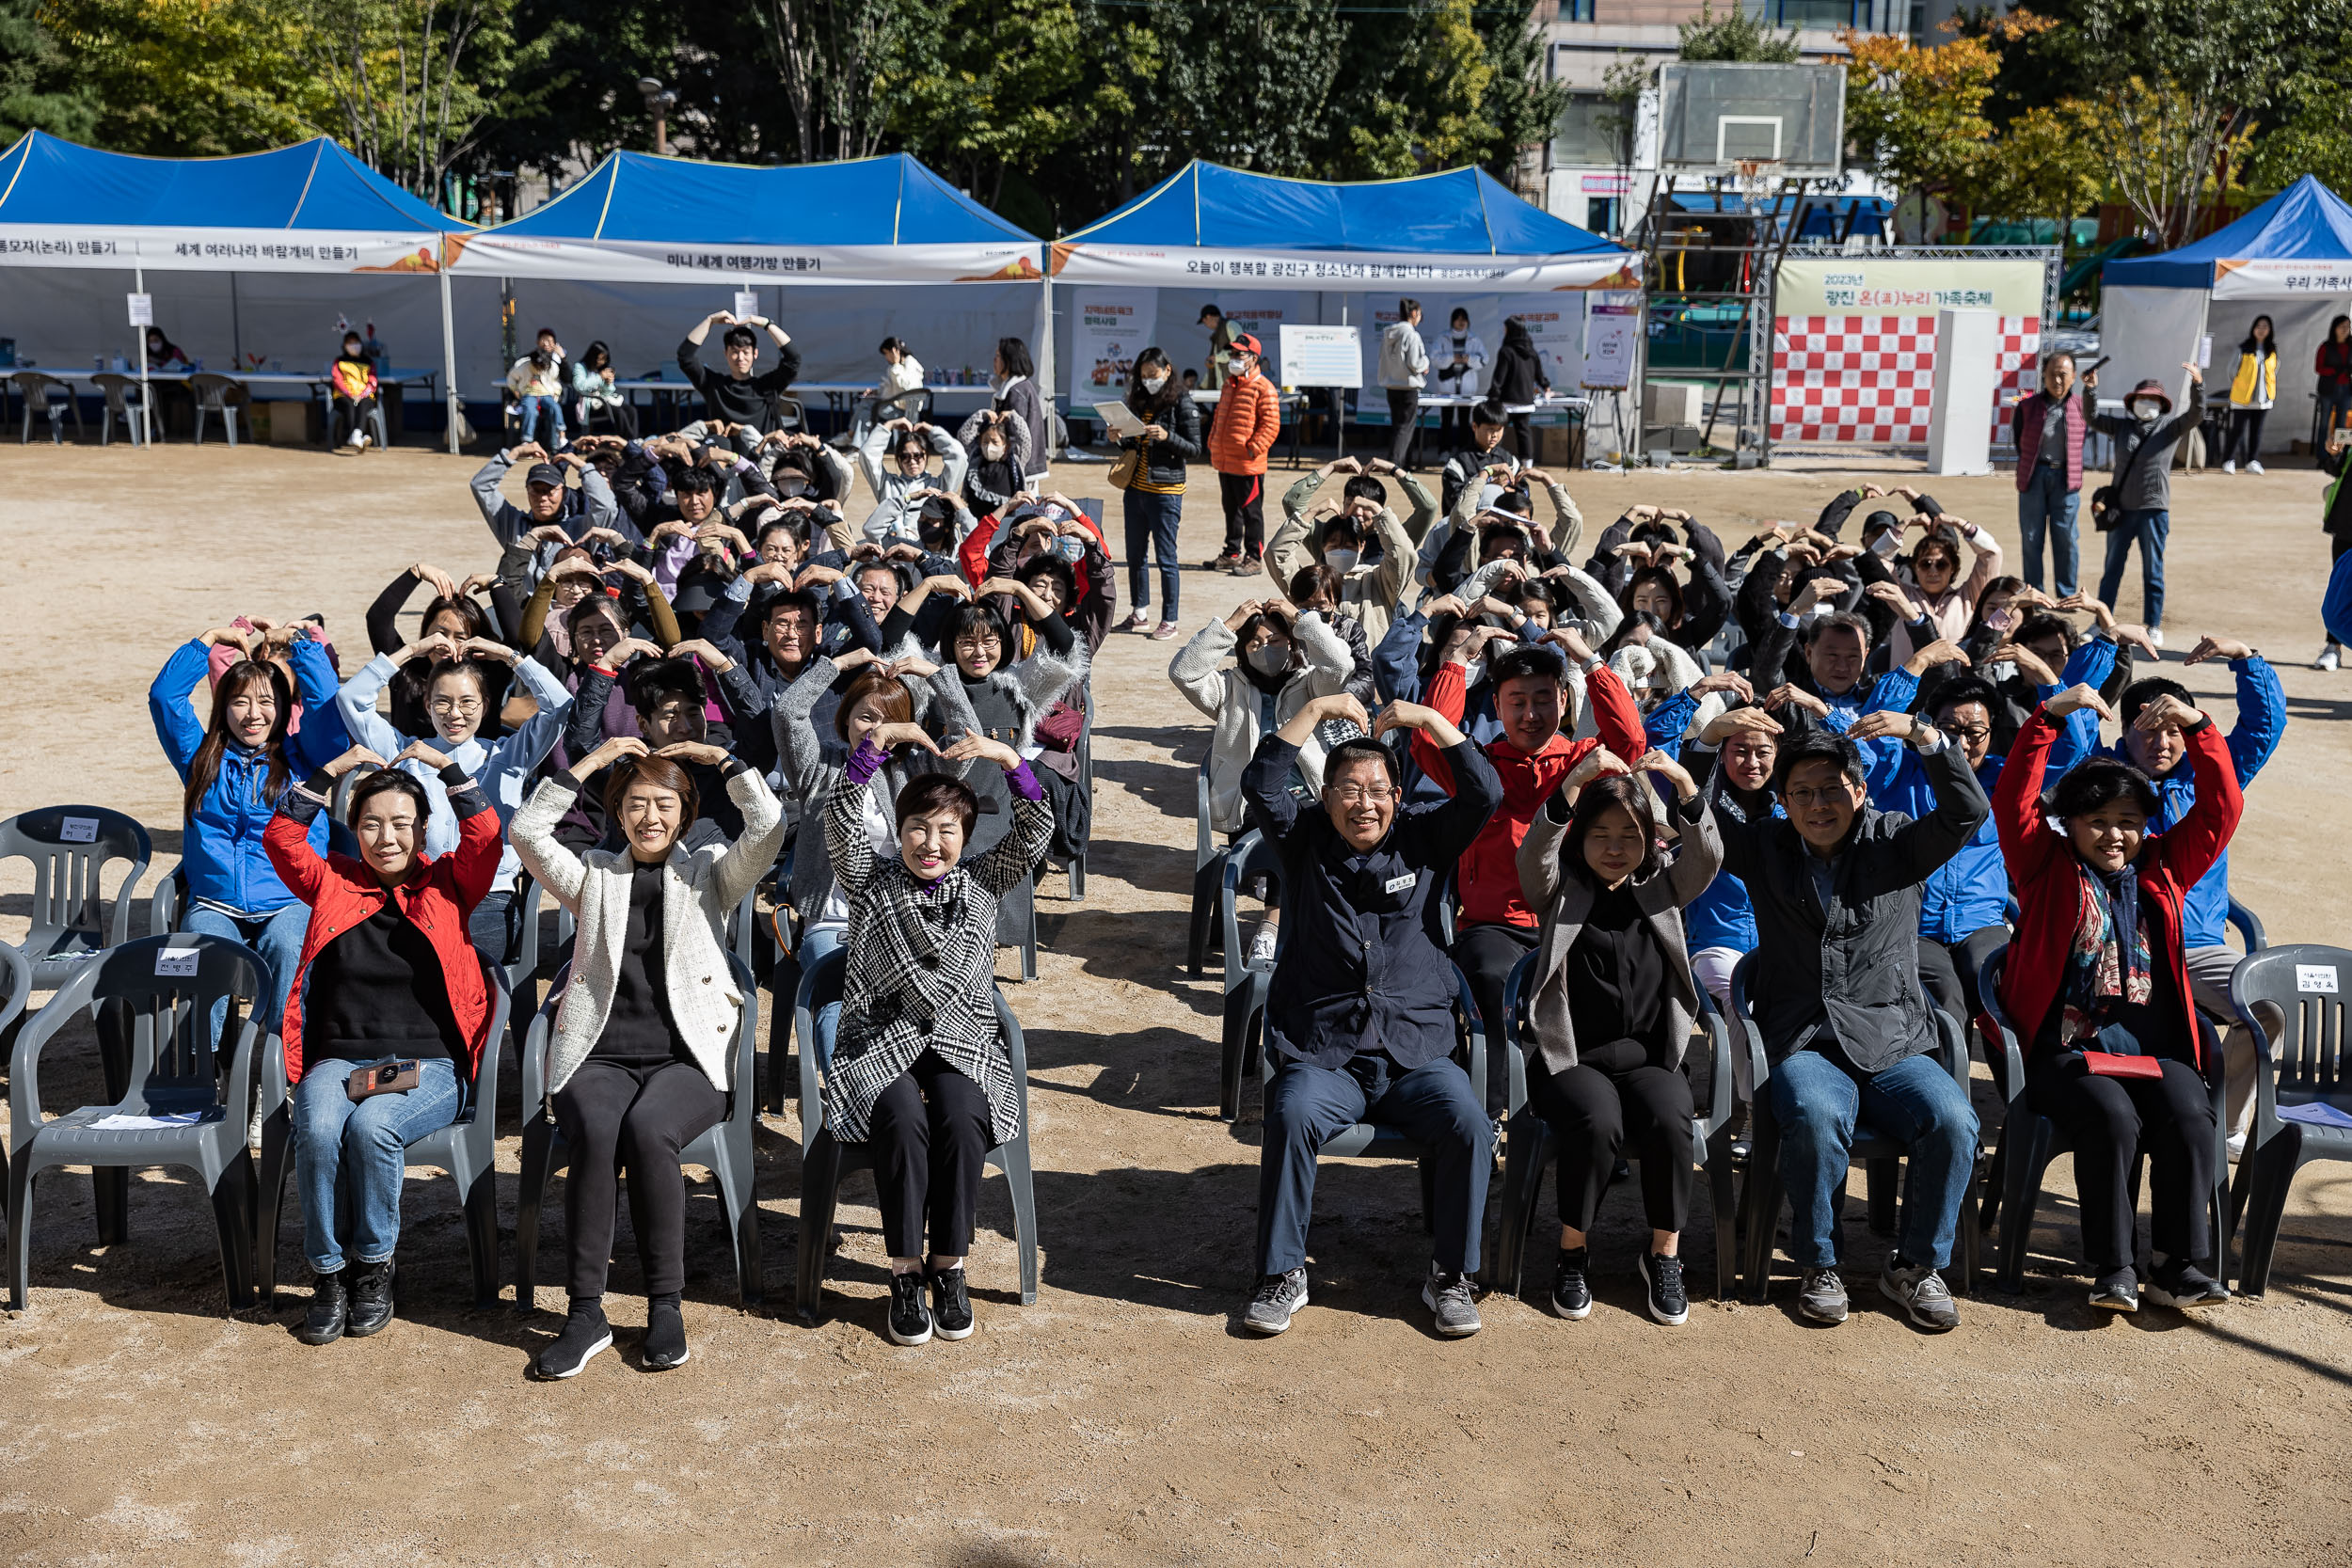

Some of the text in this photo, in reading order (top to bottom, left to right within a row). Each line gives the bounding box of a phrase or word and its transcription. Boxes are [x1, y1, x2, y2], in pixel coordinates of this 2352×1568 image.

[77, 240, 118, 256] 만들기
[175, 242, 358, 261] 세계 여러나라 바람개비 만들기
[667, 253, 821, 272] 미니 세계 여행가방 만들기
[1186, 261, 1224, 275] 오늘이
[1229, 261, 1267, 277] 행복할
[1272, 261, 1310, 277] 광진구
[1314, 262, 1364, 278] 청소년과
[1370, 263, 1433, 279] 함께합니다
[1824, 274, 1864, 286] 2023년
[2284, 276, 2311, 291] 우리
[1825, 291, 1854, 307] 광진
[1934, 291, 1994, 306] 가족축제
